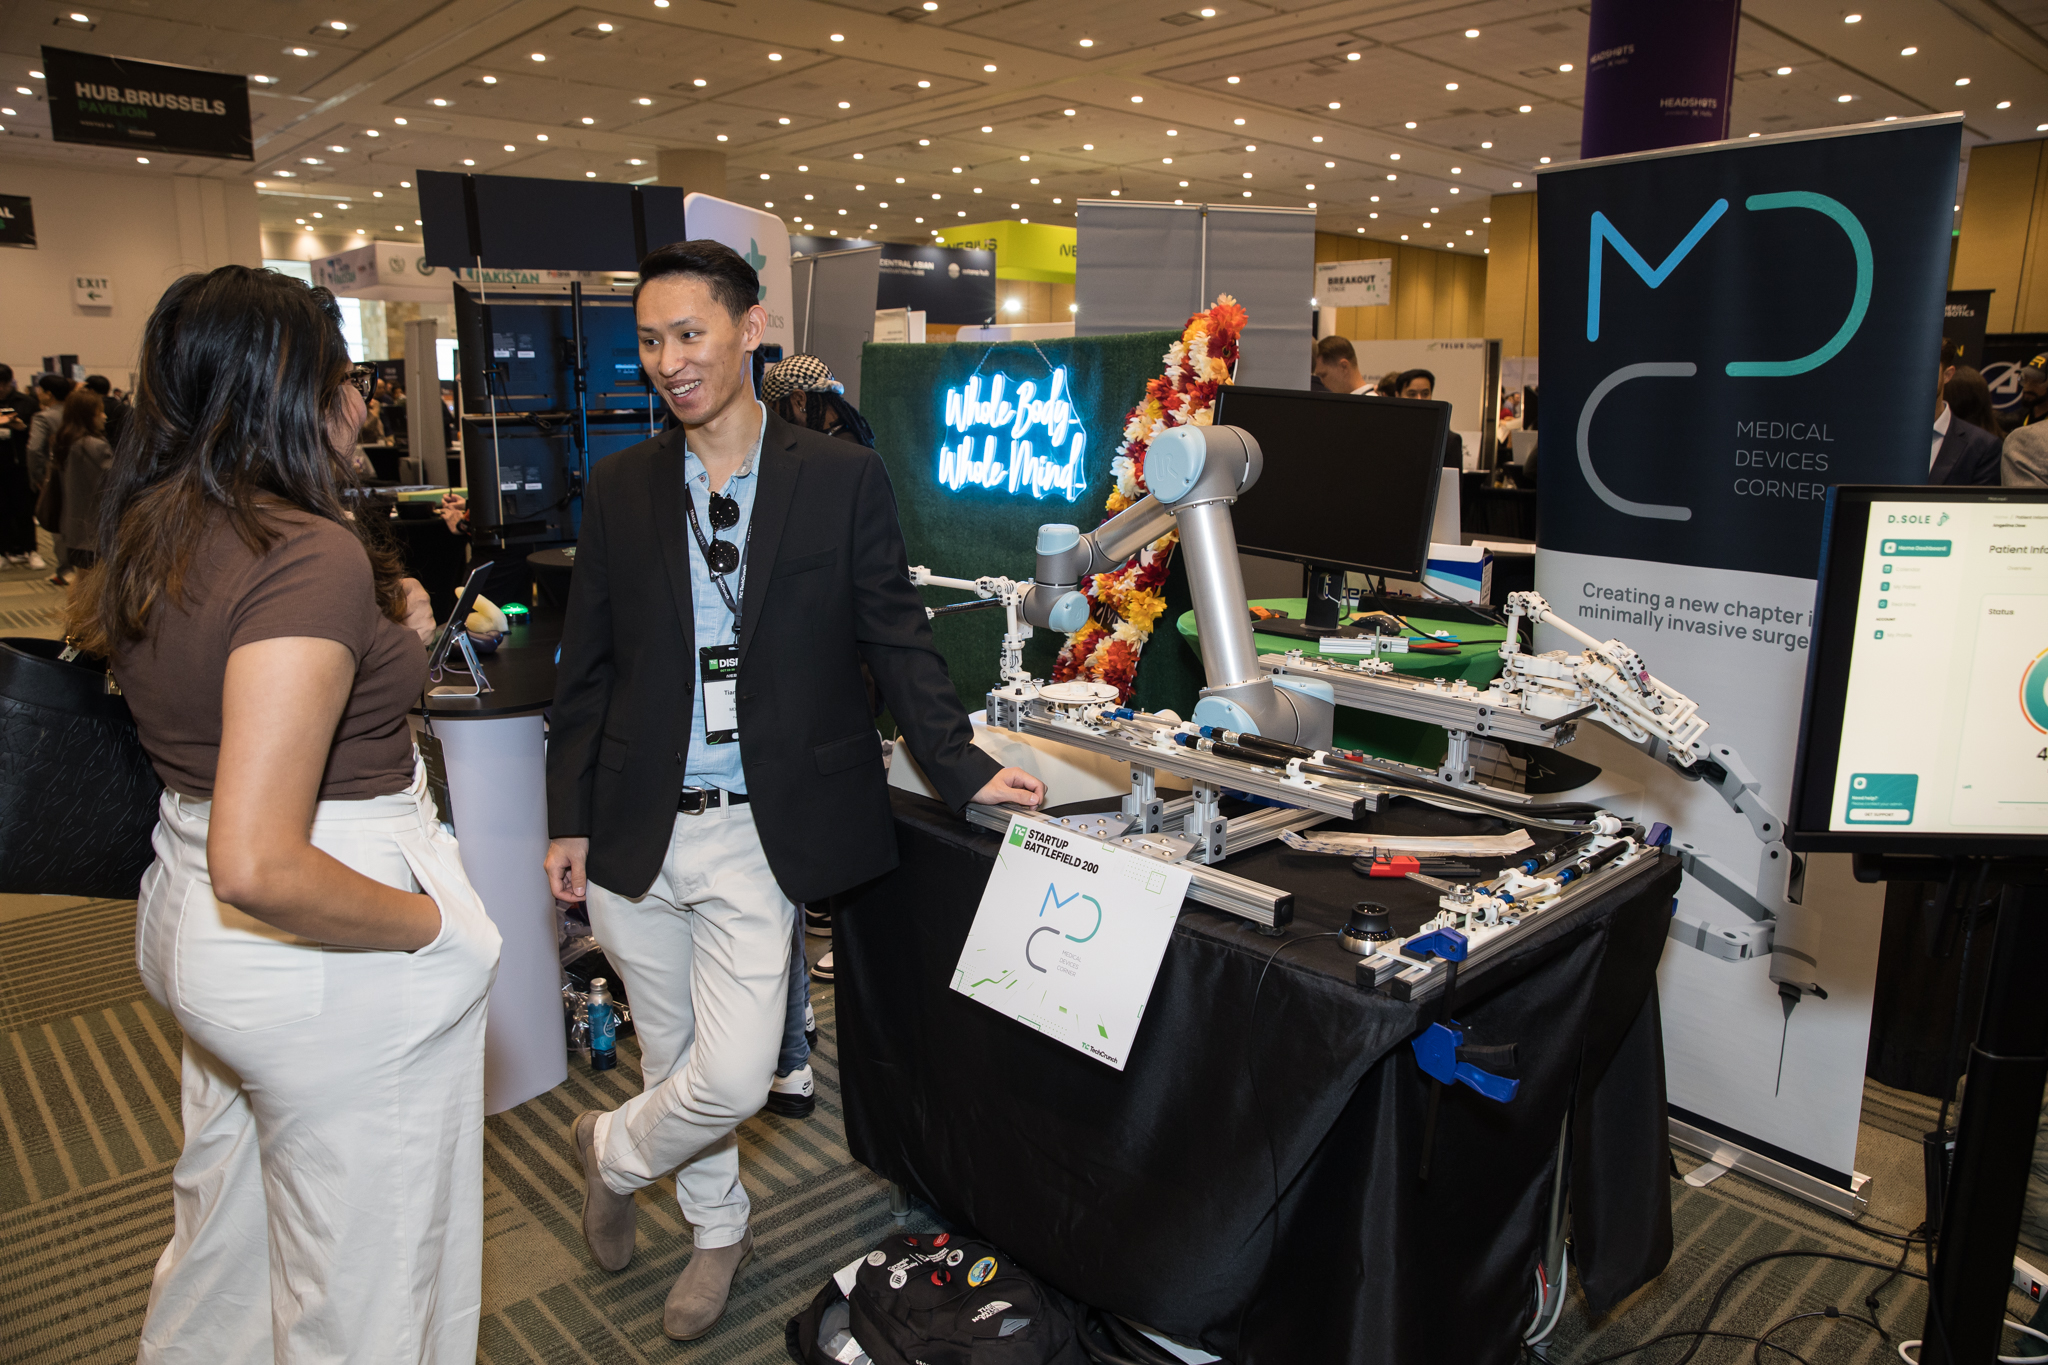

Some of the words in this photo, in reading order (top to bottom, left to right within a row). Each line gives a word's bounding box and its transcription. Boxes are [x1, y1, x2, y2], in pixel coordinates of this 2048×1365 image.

[75, 81, 227, 116] HUB.BRUSSELS
[1660, 97, 1717, 109] HEADSHOTS
[78, 101, 148, 119] PAVILION
[879, 258, 912, 269] CENTRAL
[912, 260, 935, 270] ASIAN
[77, 277, 109, 289] EXIT
[1328, 275, 1376, 285] BREAKOUT
[945, 375, 1017, 433] Whole
[1010, 368, 1080, 447] Body
[1736, 421, 1835, 441] MEDICAL
[938, 434, 1009, 491] Whole
[1009, 432, 1086, 502] Mind
[1735, 449, 1829, 471] DEVICES
[1733, 478, 1826, 501] CORNER
[1887, 514, 1931, 524] D.SOLE
[1989, 545, 2028, 554] Patient
[1582, 582, 1660, 611] Creating
[1665, 595, 1675, 609] a
[1679, 597, 1719, 614] new
[1724, 601, 1803, 625] chapter
[1808, 610, 1814, 627] i
[1988, 608, 2014, 616] Status
[1578, 605, 1664, 632] minimally
[1667, 614, 1747, 639] invasive
[1751, 628, 1809, 652] surge
[1028, 829, 1069, 850] STARTUP
[1024, 839, 1082, 868] BATTLEFIELD
[1081, 860, 1099, 874] 200
[1059, 957, 1079, 970] DEVICES
[1061, 949, 1082, 963] MEDICAL
[1056, 965, 1077, 978] CORNER
[1089, 1045, 1118, 1064] TechCrunch
